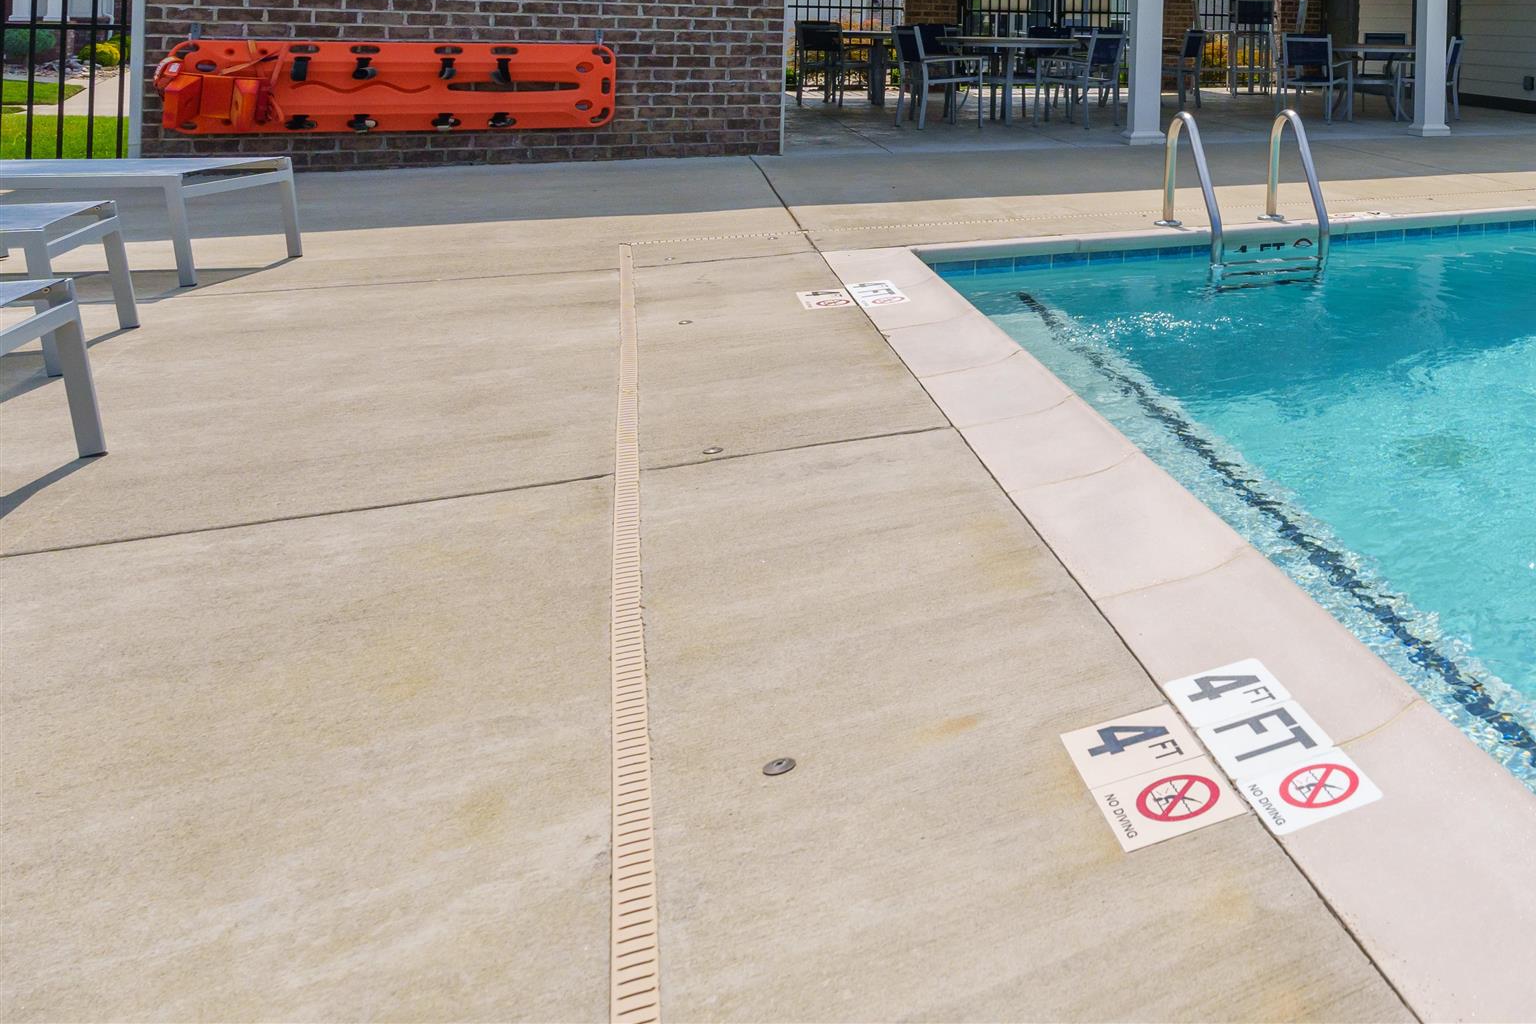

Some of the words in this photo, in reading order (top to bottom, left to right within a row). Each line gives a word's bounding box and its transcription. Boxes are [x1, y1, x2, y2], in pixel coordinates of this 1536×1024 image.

[1187, 675, 1261, 703] 4
[1242, 685, 1277, 704] FT
[1087, 725, 1170, 757] 4
[1148, 738, 1184, 759] FT
[1213, 707, 1319, 762] FT
[1104, 793, 1120, 807] NO
[1113, 807, 1138, 839] DIVING
[1248, 783, 1264, 797] NO
[1258, 796, 1286, 826] DIVING
